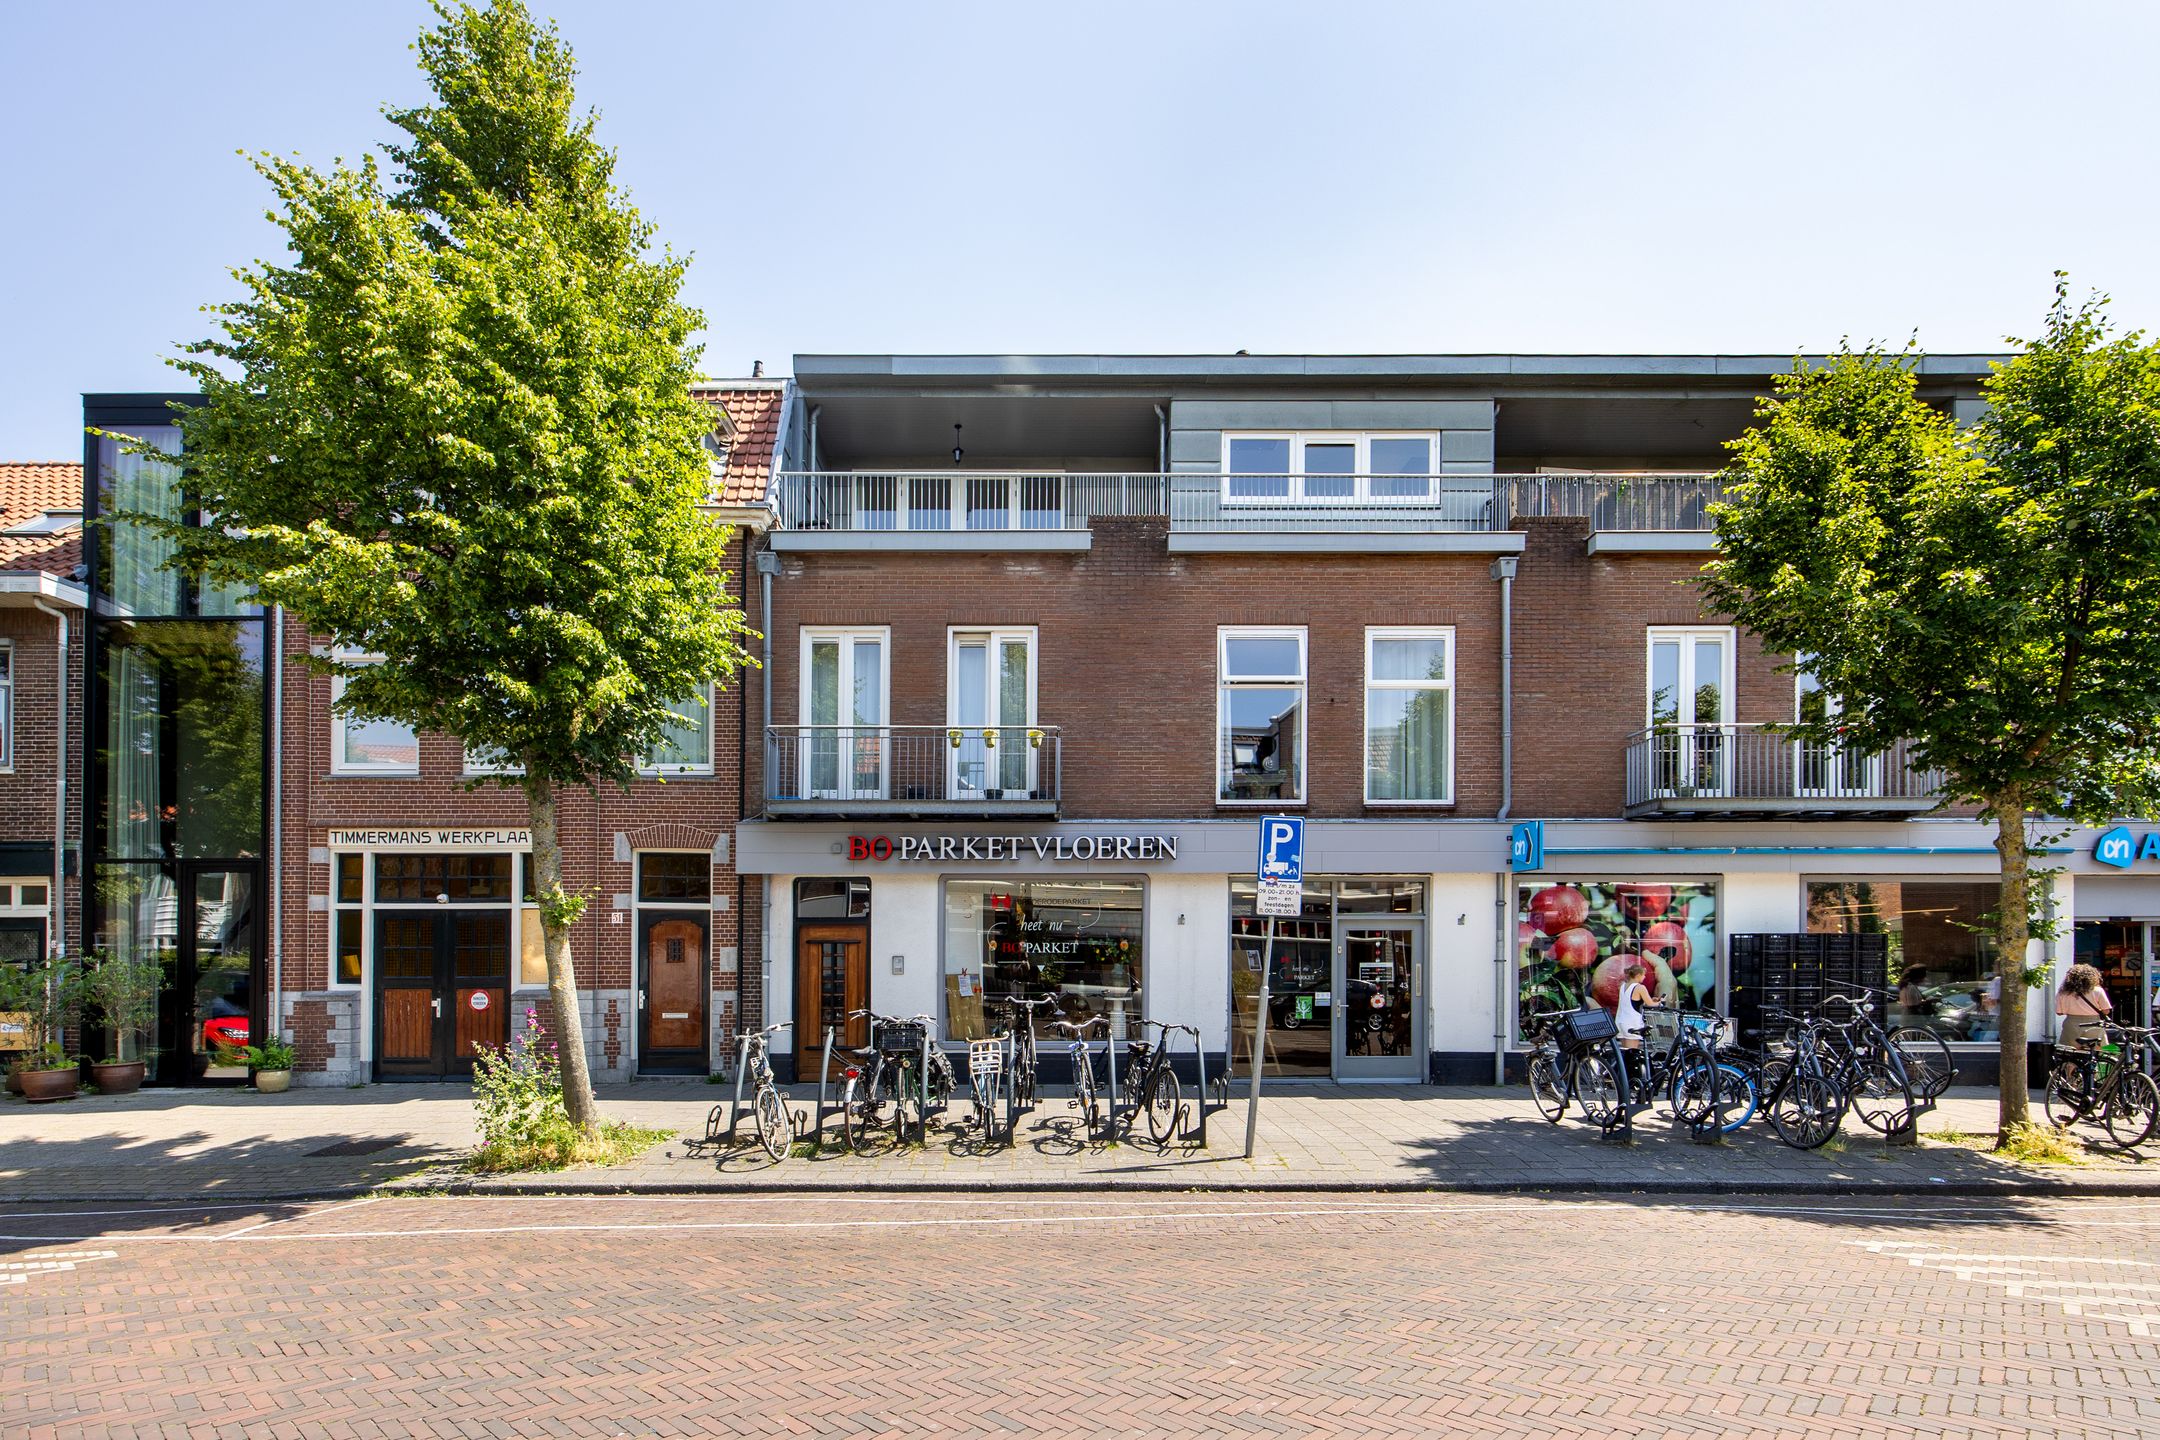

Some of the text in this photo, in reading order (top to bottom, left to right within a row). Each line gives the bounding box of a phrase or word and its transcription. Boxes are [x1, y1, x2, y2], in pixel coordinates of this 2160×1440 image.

[330, 831, 532, 844] TIMMERMANS WERKPLAA
[1270, 823, 1294, 855] P
[847, 835, 1180, 861] BO PARKET VLOEREN
[612, 914, 622, 922] 51
[1020, 915, 1063, 931] heet nu
[1026, 942, 1078, 953] PARKET
